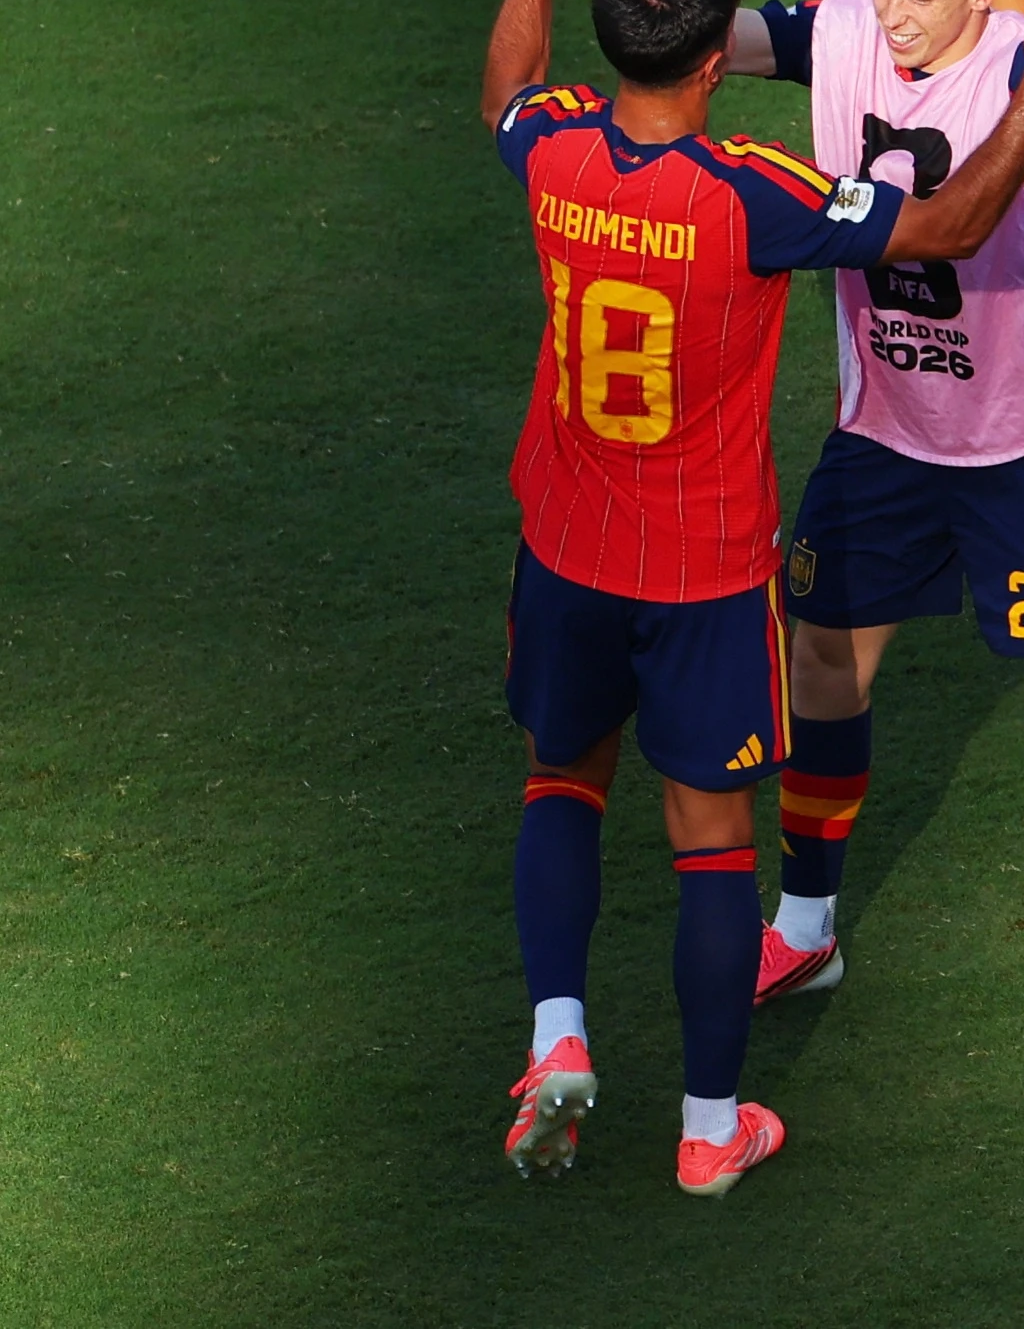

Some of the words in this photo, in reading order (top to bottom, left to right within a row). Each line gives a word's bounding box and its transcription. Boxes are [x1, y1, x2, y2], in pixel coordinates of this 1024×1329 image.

[537, 191, 696, 261] ZUBIMENDI
[889, 272, 936, 302] FIFA
[550, 257, 675, 444] 18
[869, 329, 974, 380] 2026
[934, 328, 969, 348] CUP
